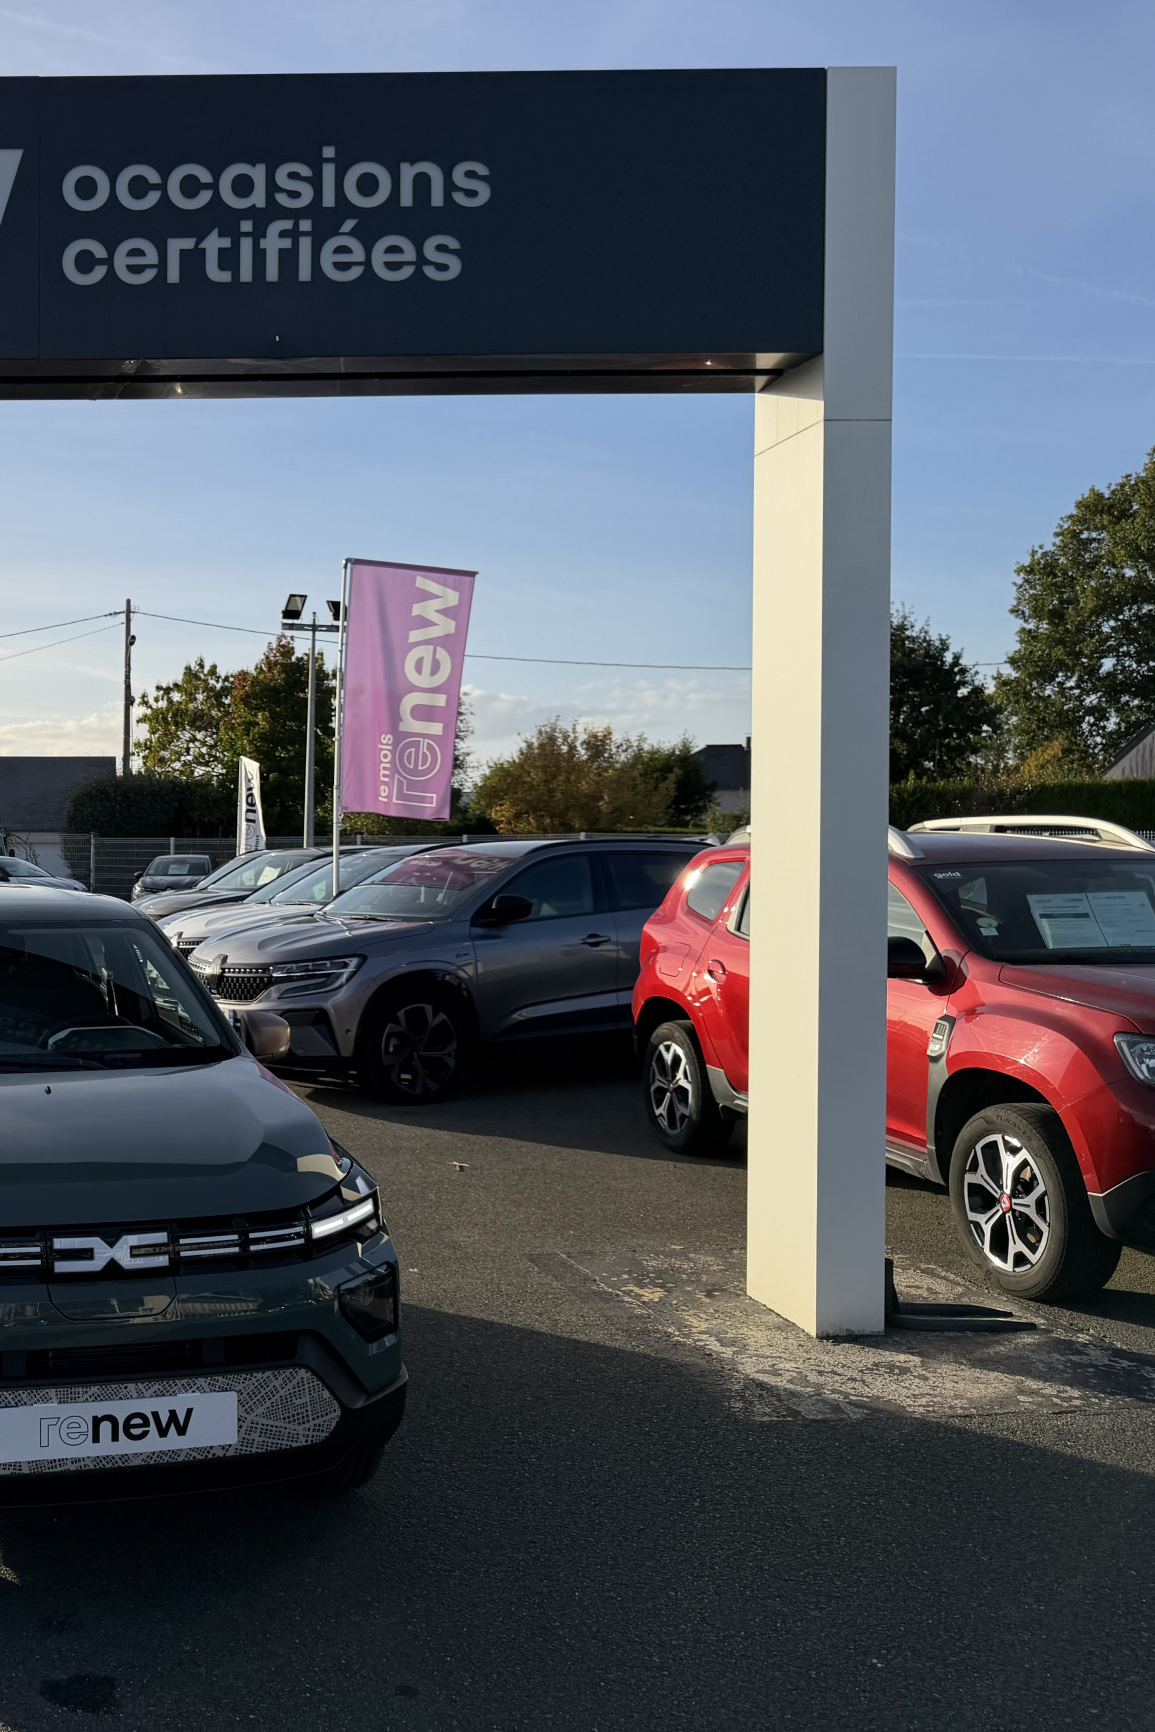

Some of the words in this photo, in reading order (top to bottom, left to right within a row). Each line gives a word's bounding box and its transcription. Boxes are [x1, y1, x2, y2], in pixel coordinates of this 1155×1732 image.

[61, 145, 492, 212] occasions
[61, 219, 463, 286] certifiées
[392, 575, 460, 807] renew
[378, 733, 394, 782] mois
[378, 787, 389, 802] le
[933, 871, 962, 879] gold
[39, 1407, 194, 1448] renew
